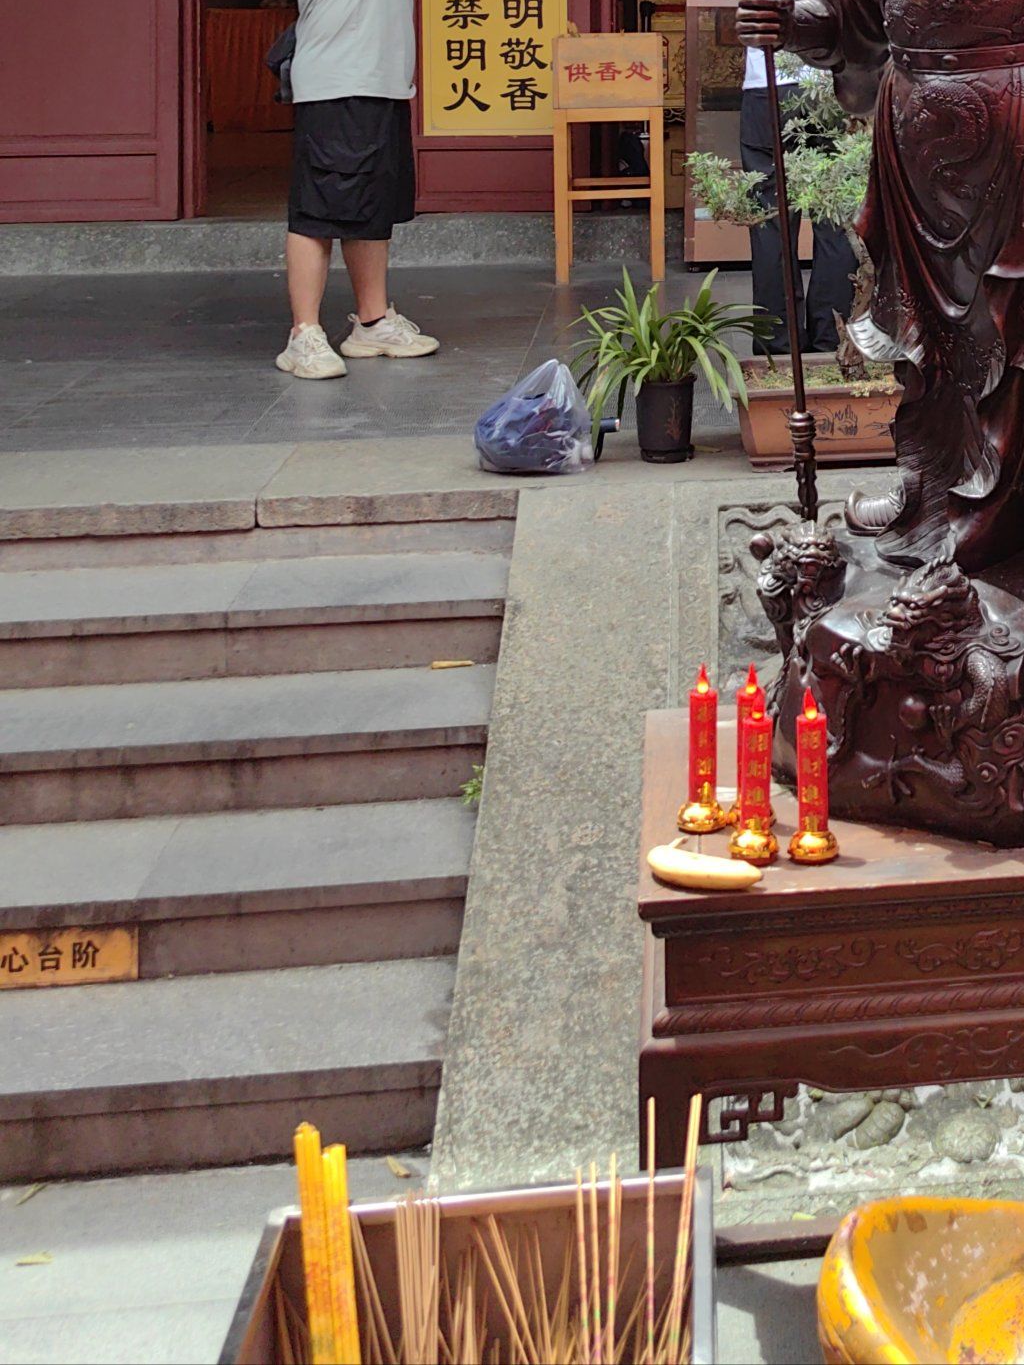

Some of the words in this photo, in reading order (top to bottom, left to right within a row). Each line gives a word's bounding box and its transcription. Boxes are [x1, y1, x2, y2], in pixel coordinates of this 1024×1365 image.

[563, 60, 653, 83] 供香处
[0, 941, 101, 973] 心台阶
